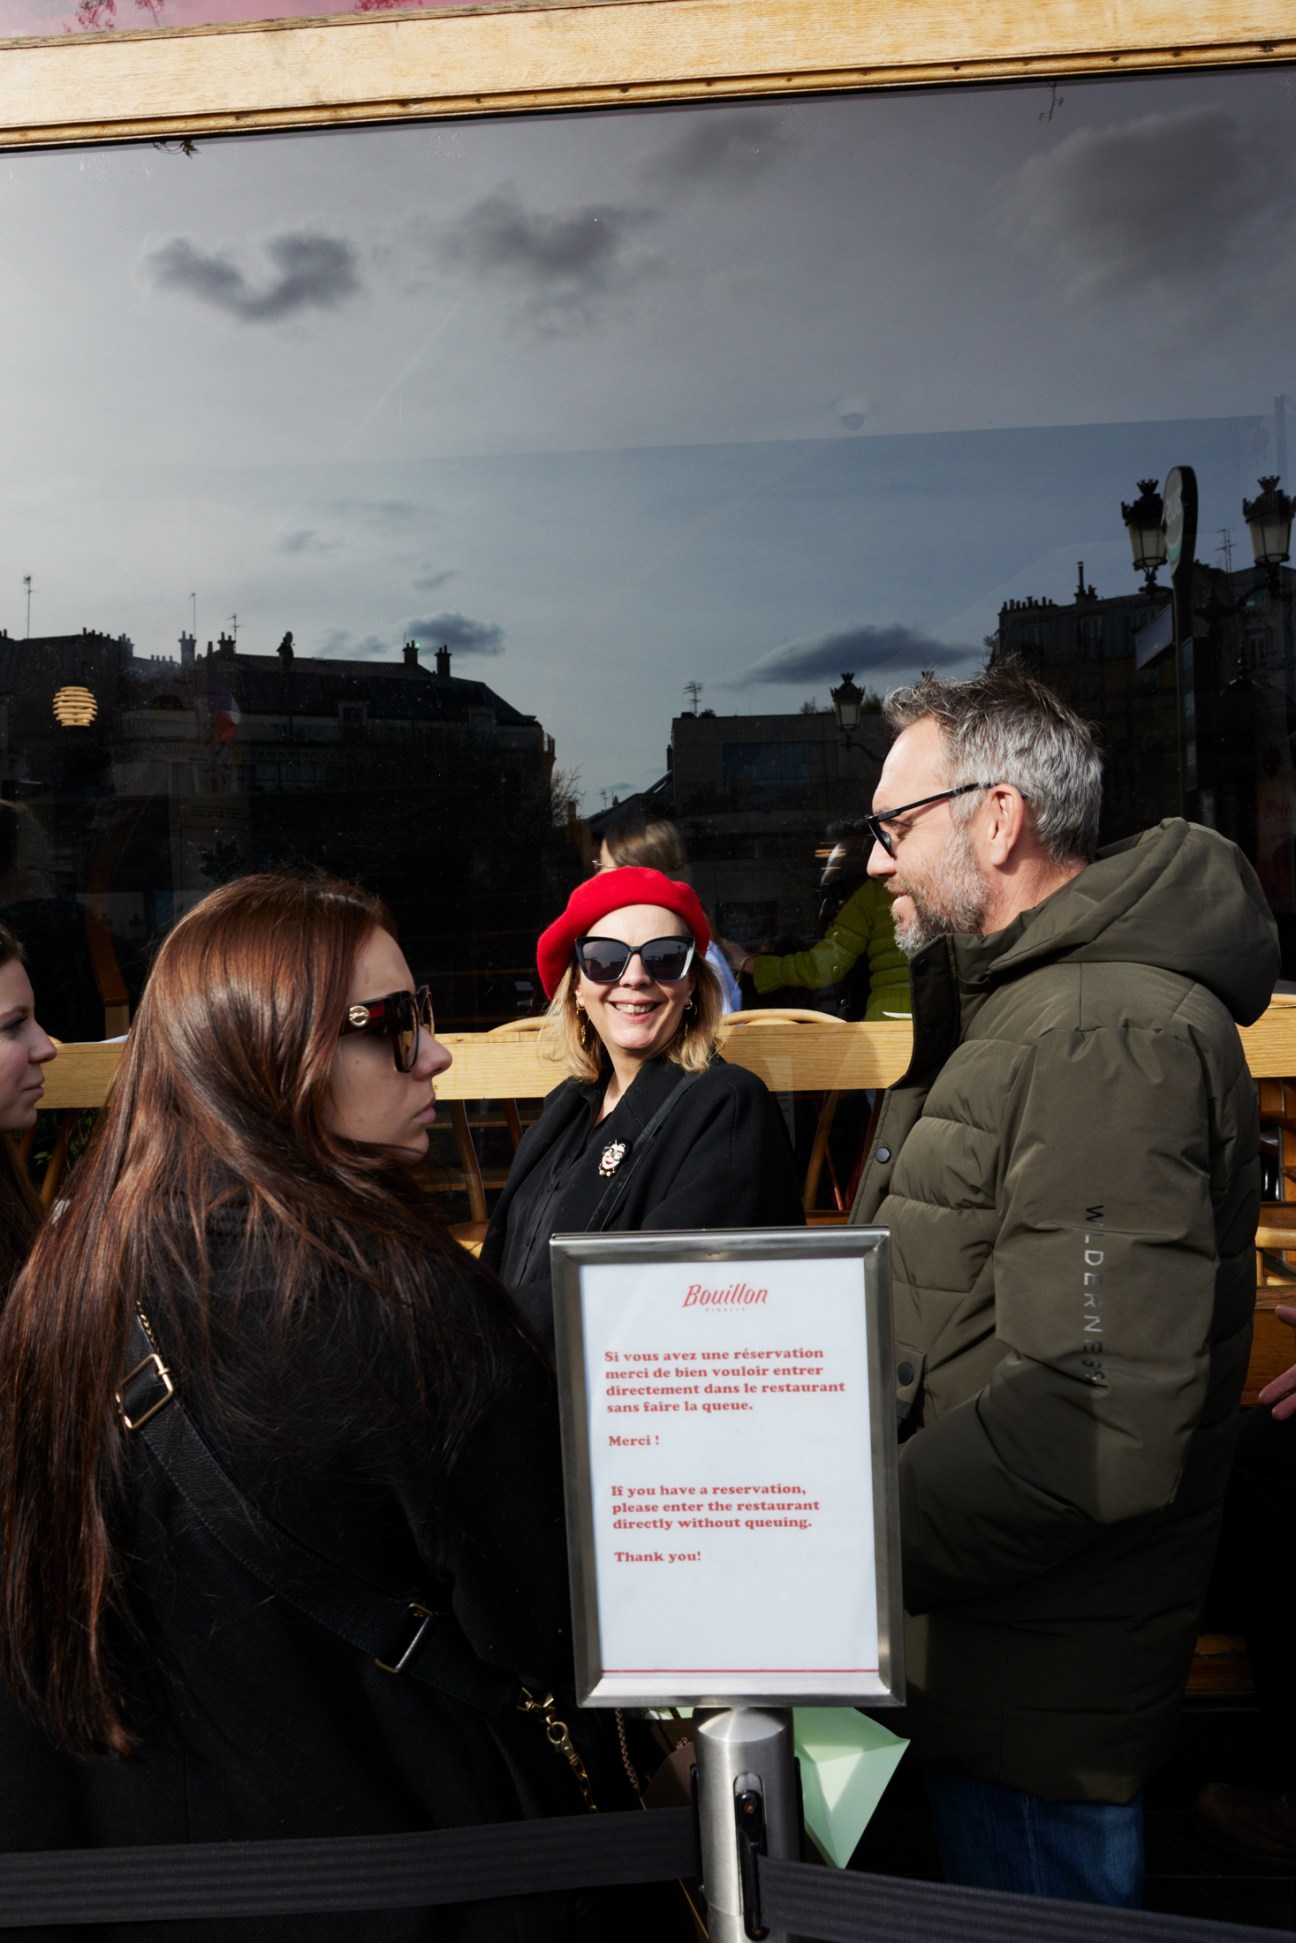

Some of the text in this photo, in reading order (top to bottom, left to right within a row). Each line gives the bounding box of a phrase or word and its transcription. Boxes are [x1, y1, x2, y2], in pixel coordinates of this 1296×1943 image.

[682, 1283, 768, 1308] Bouillon
[604, 1347, 824, 1362] Si vous avez une réservation
[604, 1365, 823, 1380] merci de bien vouloir entrer
[605, 1382, 845, 1396] directement dans le restaurant
[607, 1401, 752, 1415] sans faire la queue.
[609, 1435, 660, 1447] Merci !
[611, 1484, 807, 1499] If you have a reservation,
[612, 1500, 820, 1515] please enter the restaurant
[613, 1516, 812, 1531] directly without queuing.
[614, 1551, 701, 1564] Thank you!
